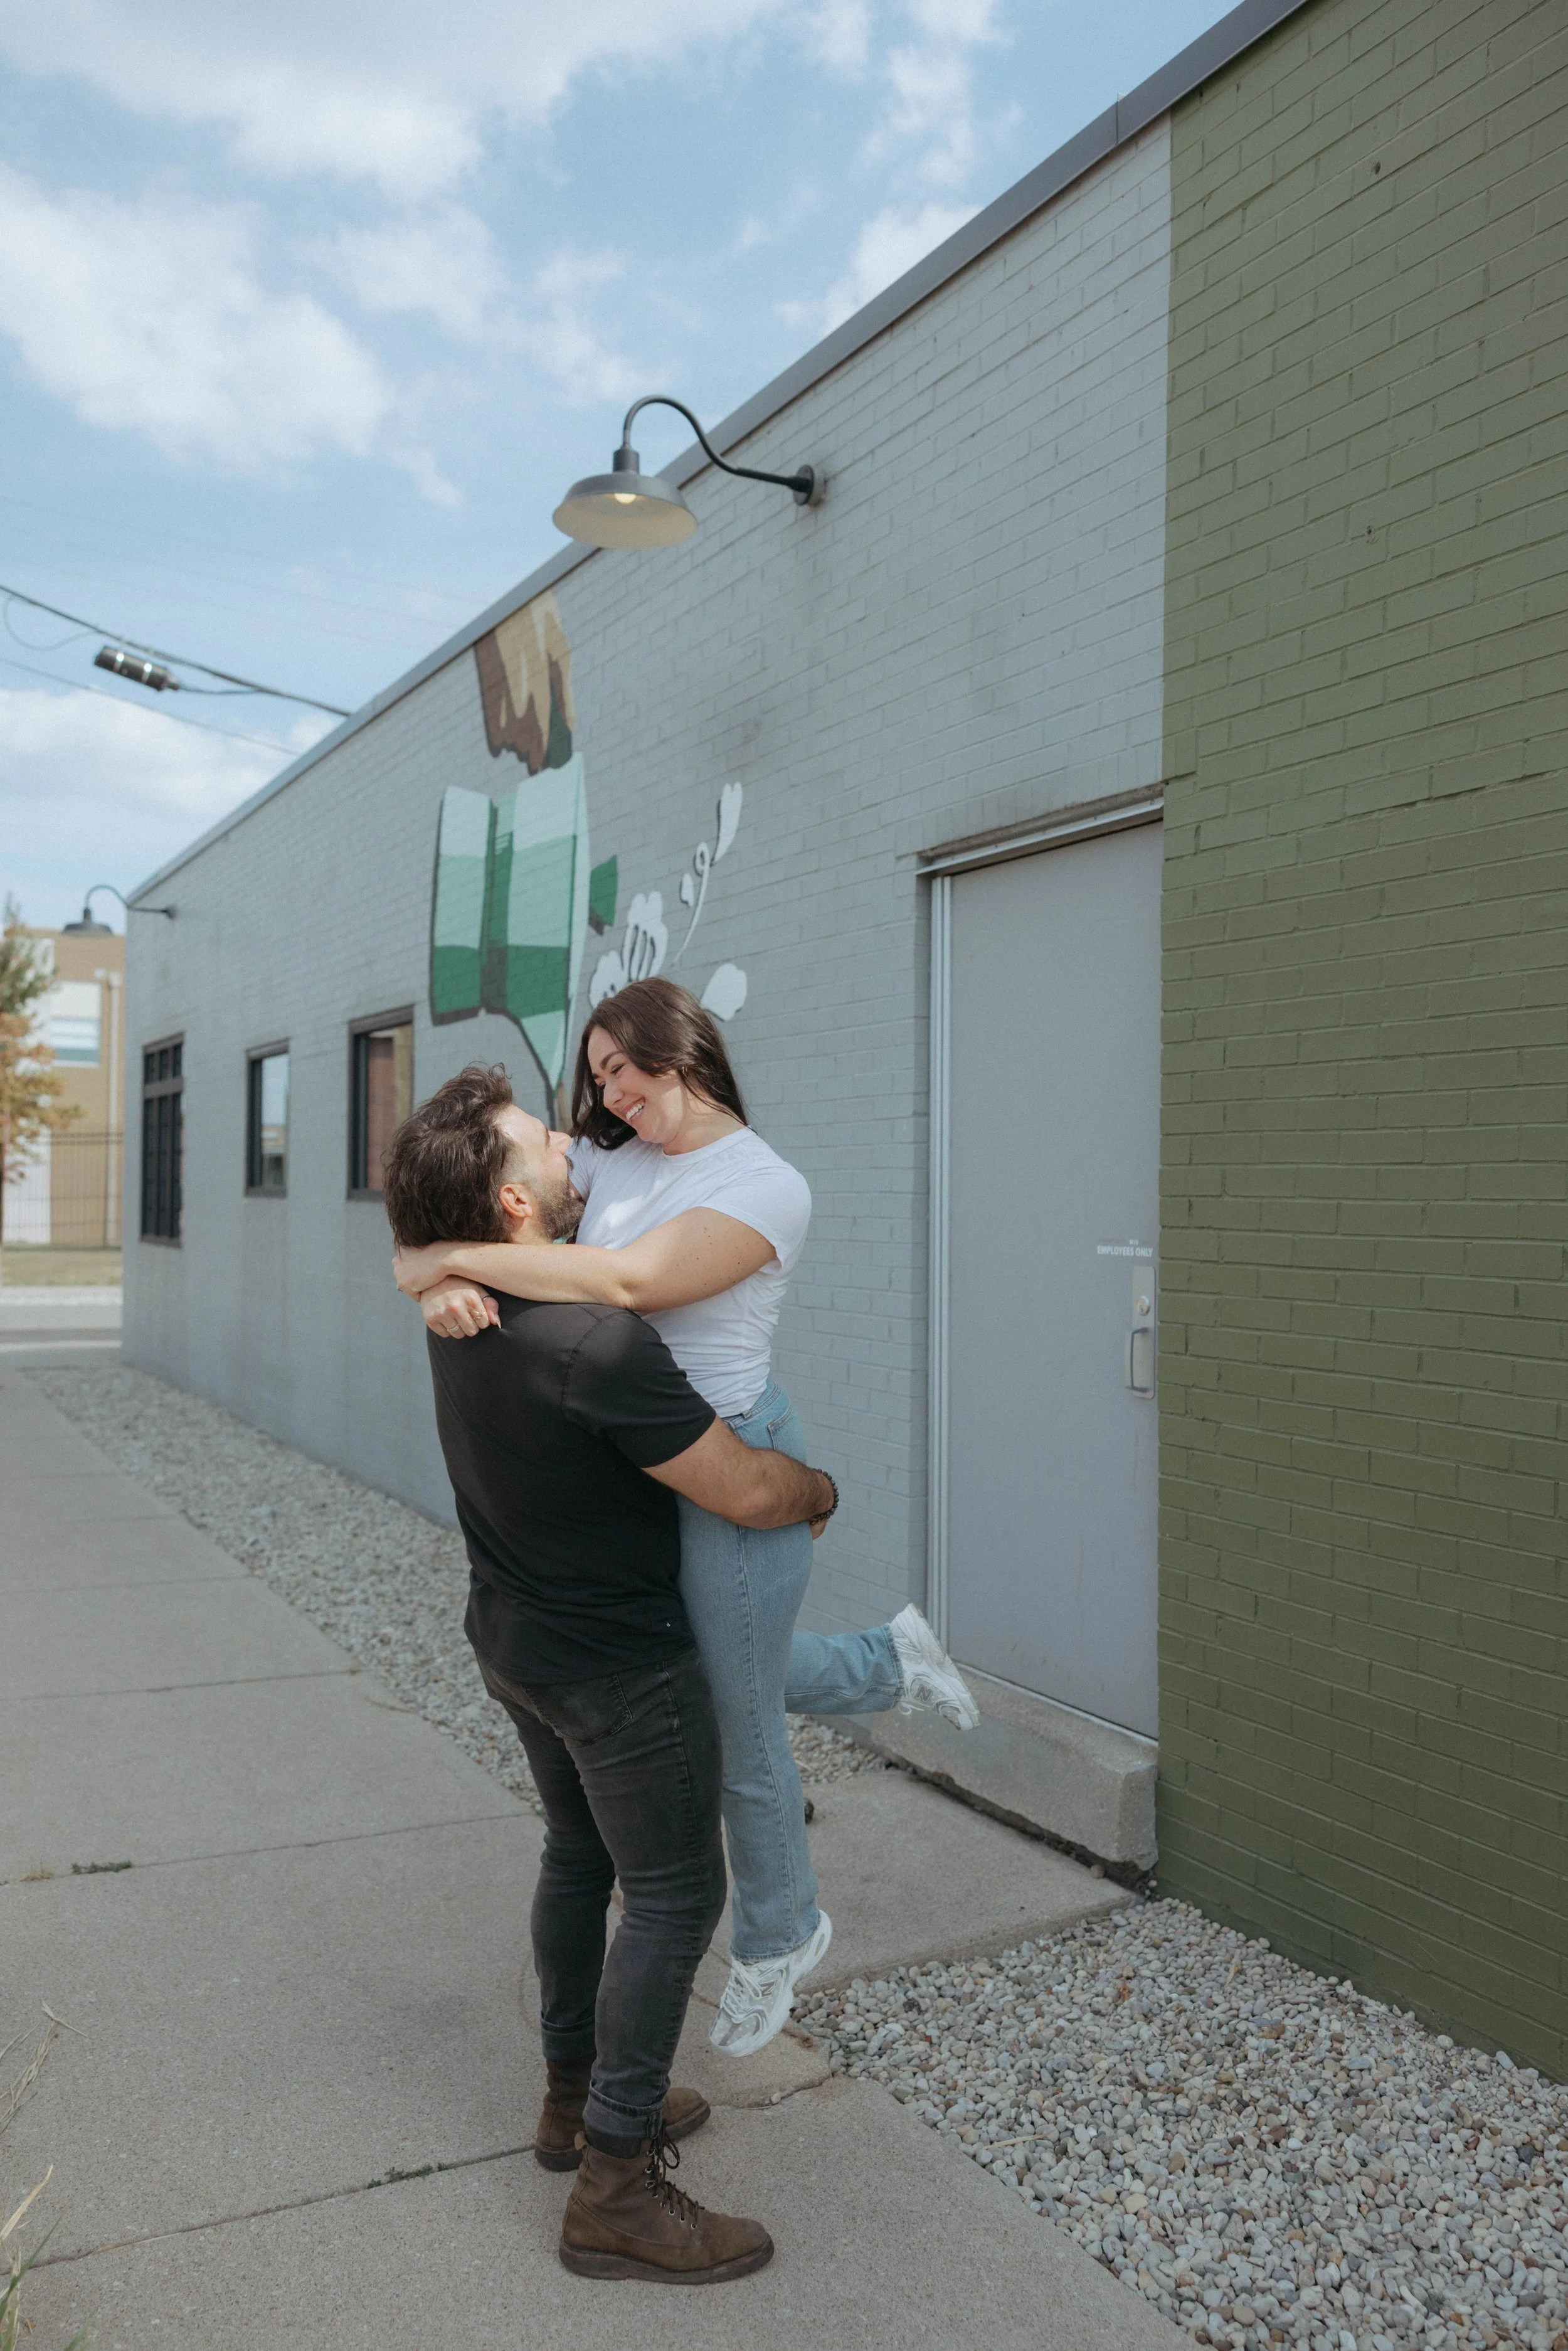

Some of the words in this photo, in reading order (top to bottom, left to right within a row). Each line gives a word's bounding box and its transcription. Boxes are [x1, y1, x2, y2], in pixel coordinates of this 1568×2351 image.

[1097, 1245, 1134, 1256] EMPLOYEES
[1135, 1247, 1153, 1257] ONLY
[915, 1684, 933, 1704] N
[759, 1979, 778, 1998] N
